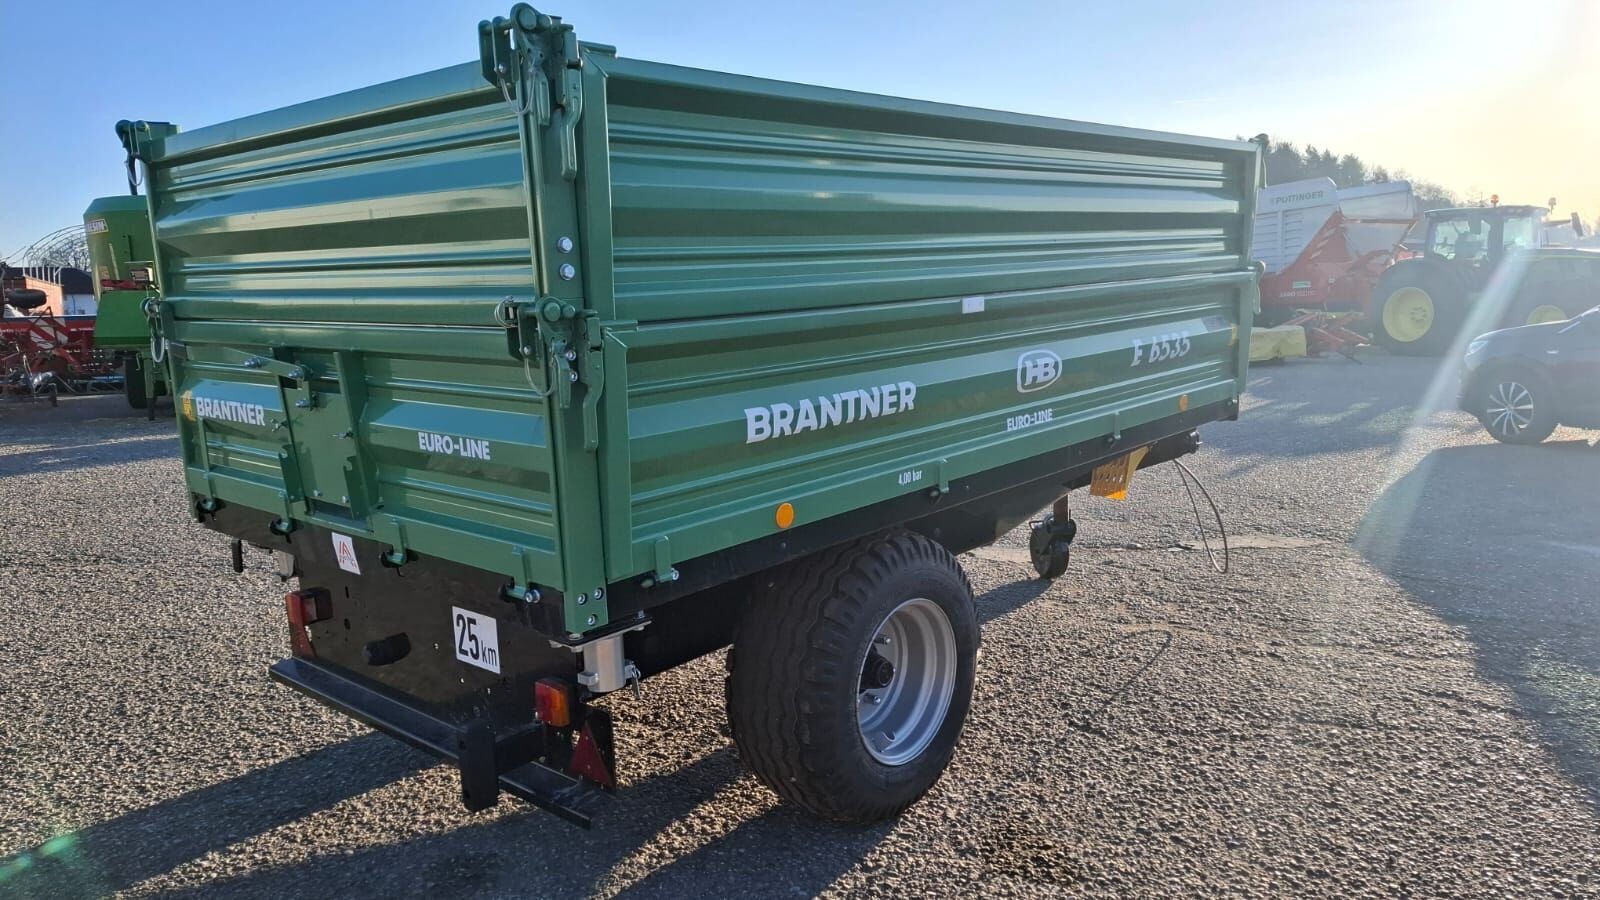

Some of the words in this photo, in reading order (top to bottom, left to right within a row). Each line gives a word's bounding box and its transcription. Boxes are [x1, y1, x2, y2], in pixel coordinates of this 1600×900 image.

[1148, 331, 1191, 363] 6535
[1024, 356, 1056, 386] HB
[195, 396, 266, 427] BRANTNER
[744, 381, 917, 444] BRANTNER
[1007, 408, 1053, 432] EURO-LINE
[418, 431, 491, 460] EURO-LINE
[912, 468, 923, 482] bar
[456, 613, 479, 660] 25
[481, 640, 497, 667] km
